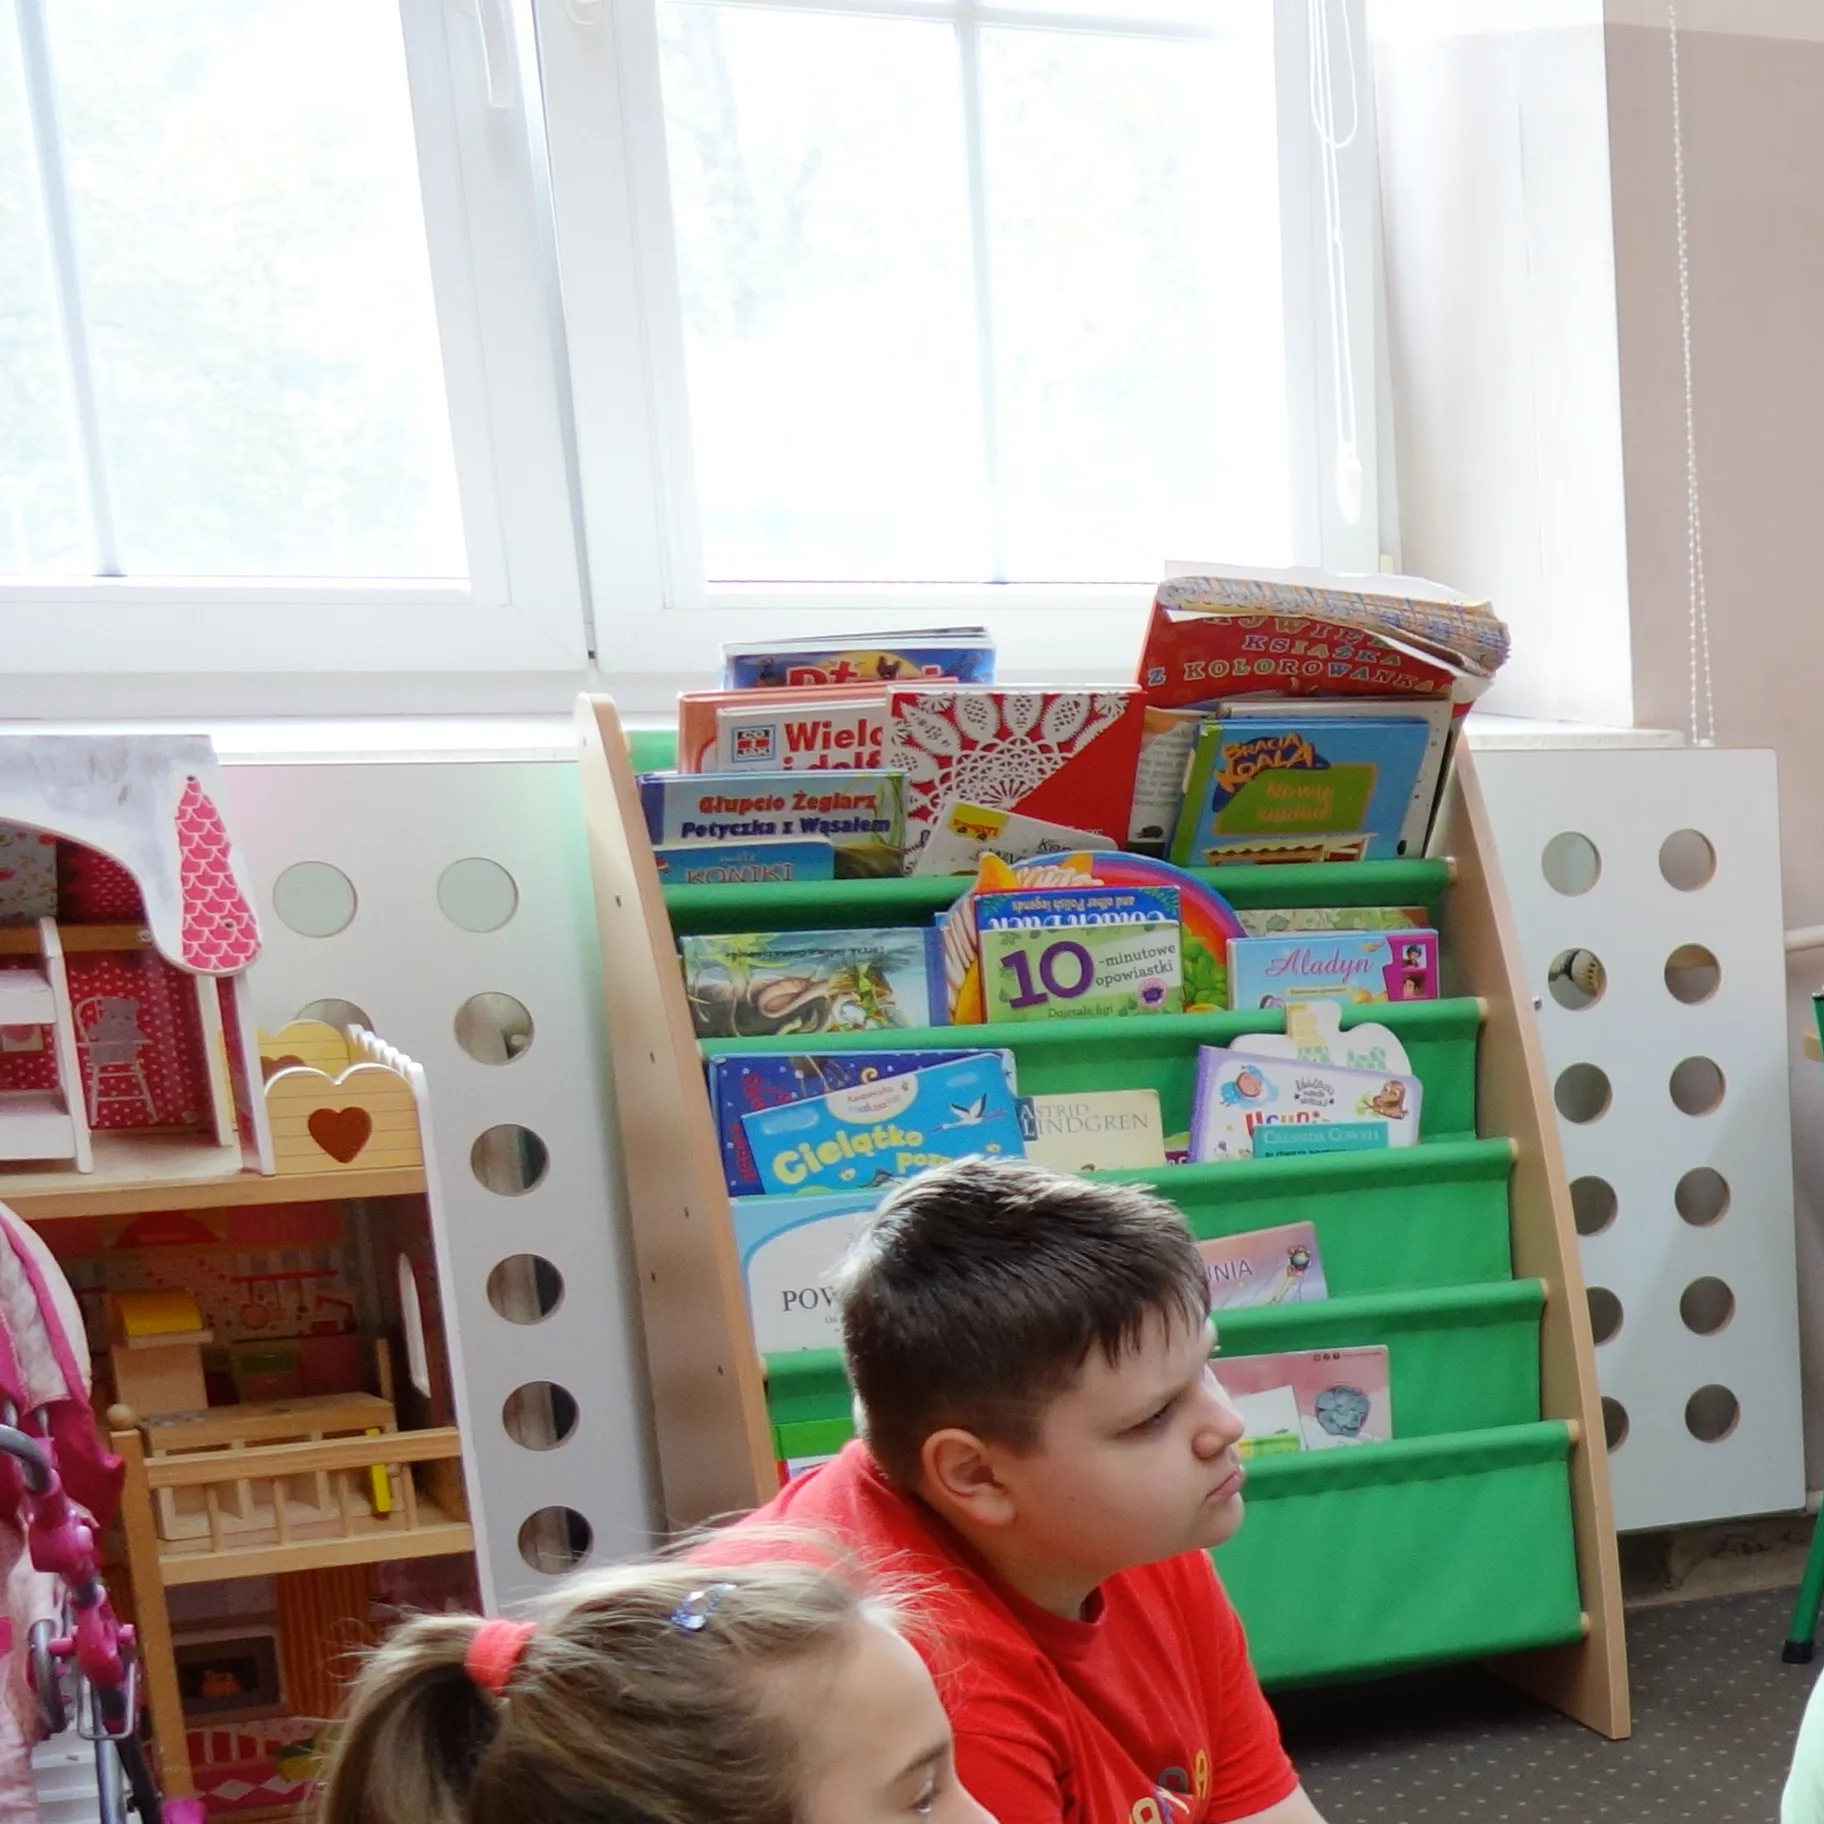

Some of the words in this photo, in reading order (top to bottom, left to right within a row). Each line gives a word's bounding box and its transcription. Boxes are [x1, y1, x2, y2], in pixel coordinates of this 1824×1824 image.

[1242, 635, 1401, 666] KSIĄŻKA
[1148, 667, 1166, 685] Z
[1223, 732, 1305, 760] BRACIA
[1216, 742, 1317, 793] KOALA
[792, 790, 877, 813] Żeglarz
[681, 820, 776, 839] Potyczka
[782, 821, 794, 833] z
[687, 863, 793, 883] KONIKI
[1000, 941, 1094, 1009] 10
[1096, 959, 1174, 986] opowiastki
[1265, 948, 1374, 982] Aladyn
[1020, 1103, 1089, 1119] ASTRID
[1023, 1112, 1149, 1136] LINDGREN
[772, 1125, 923, 1184] Cielątko
